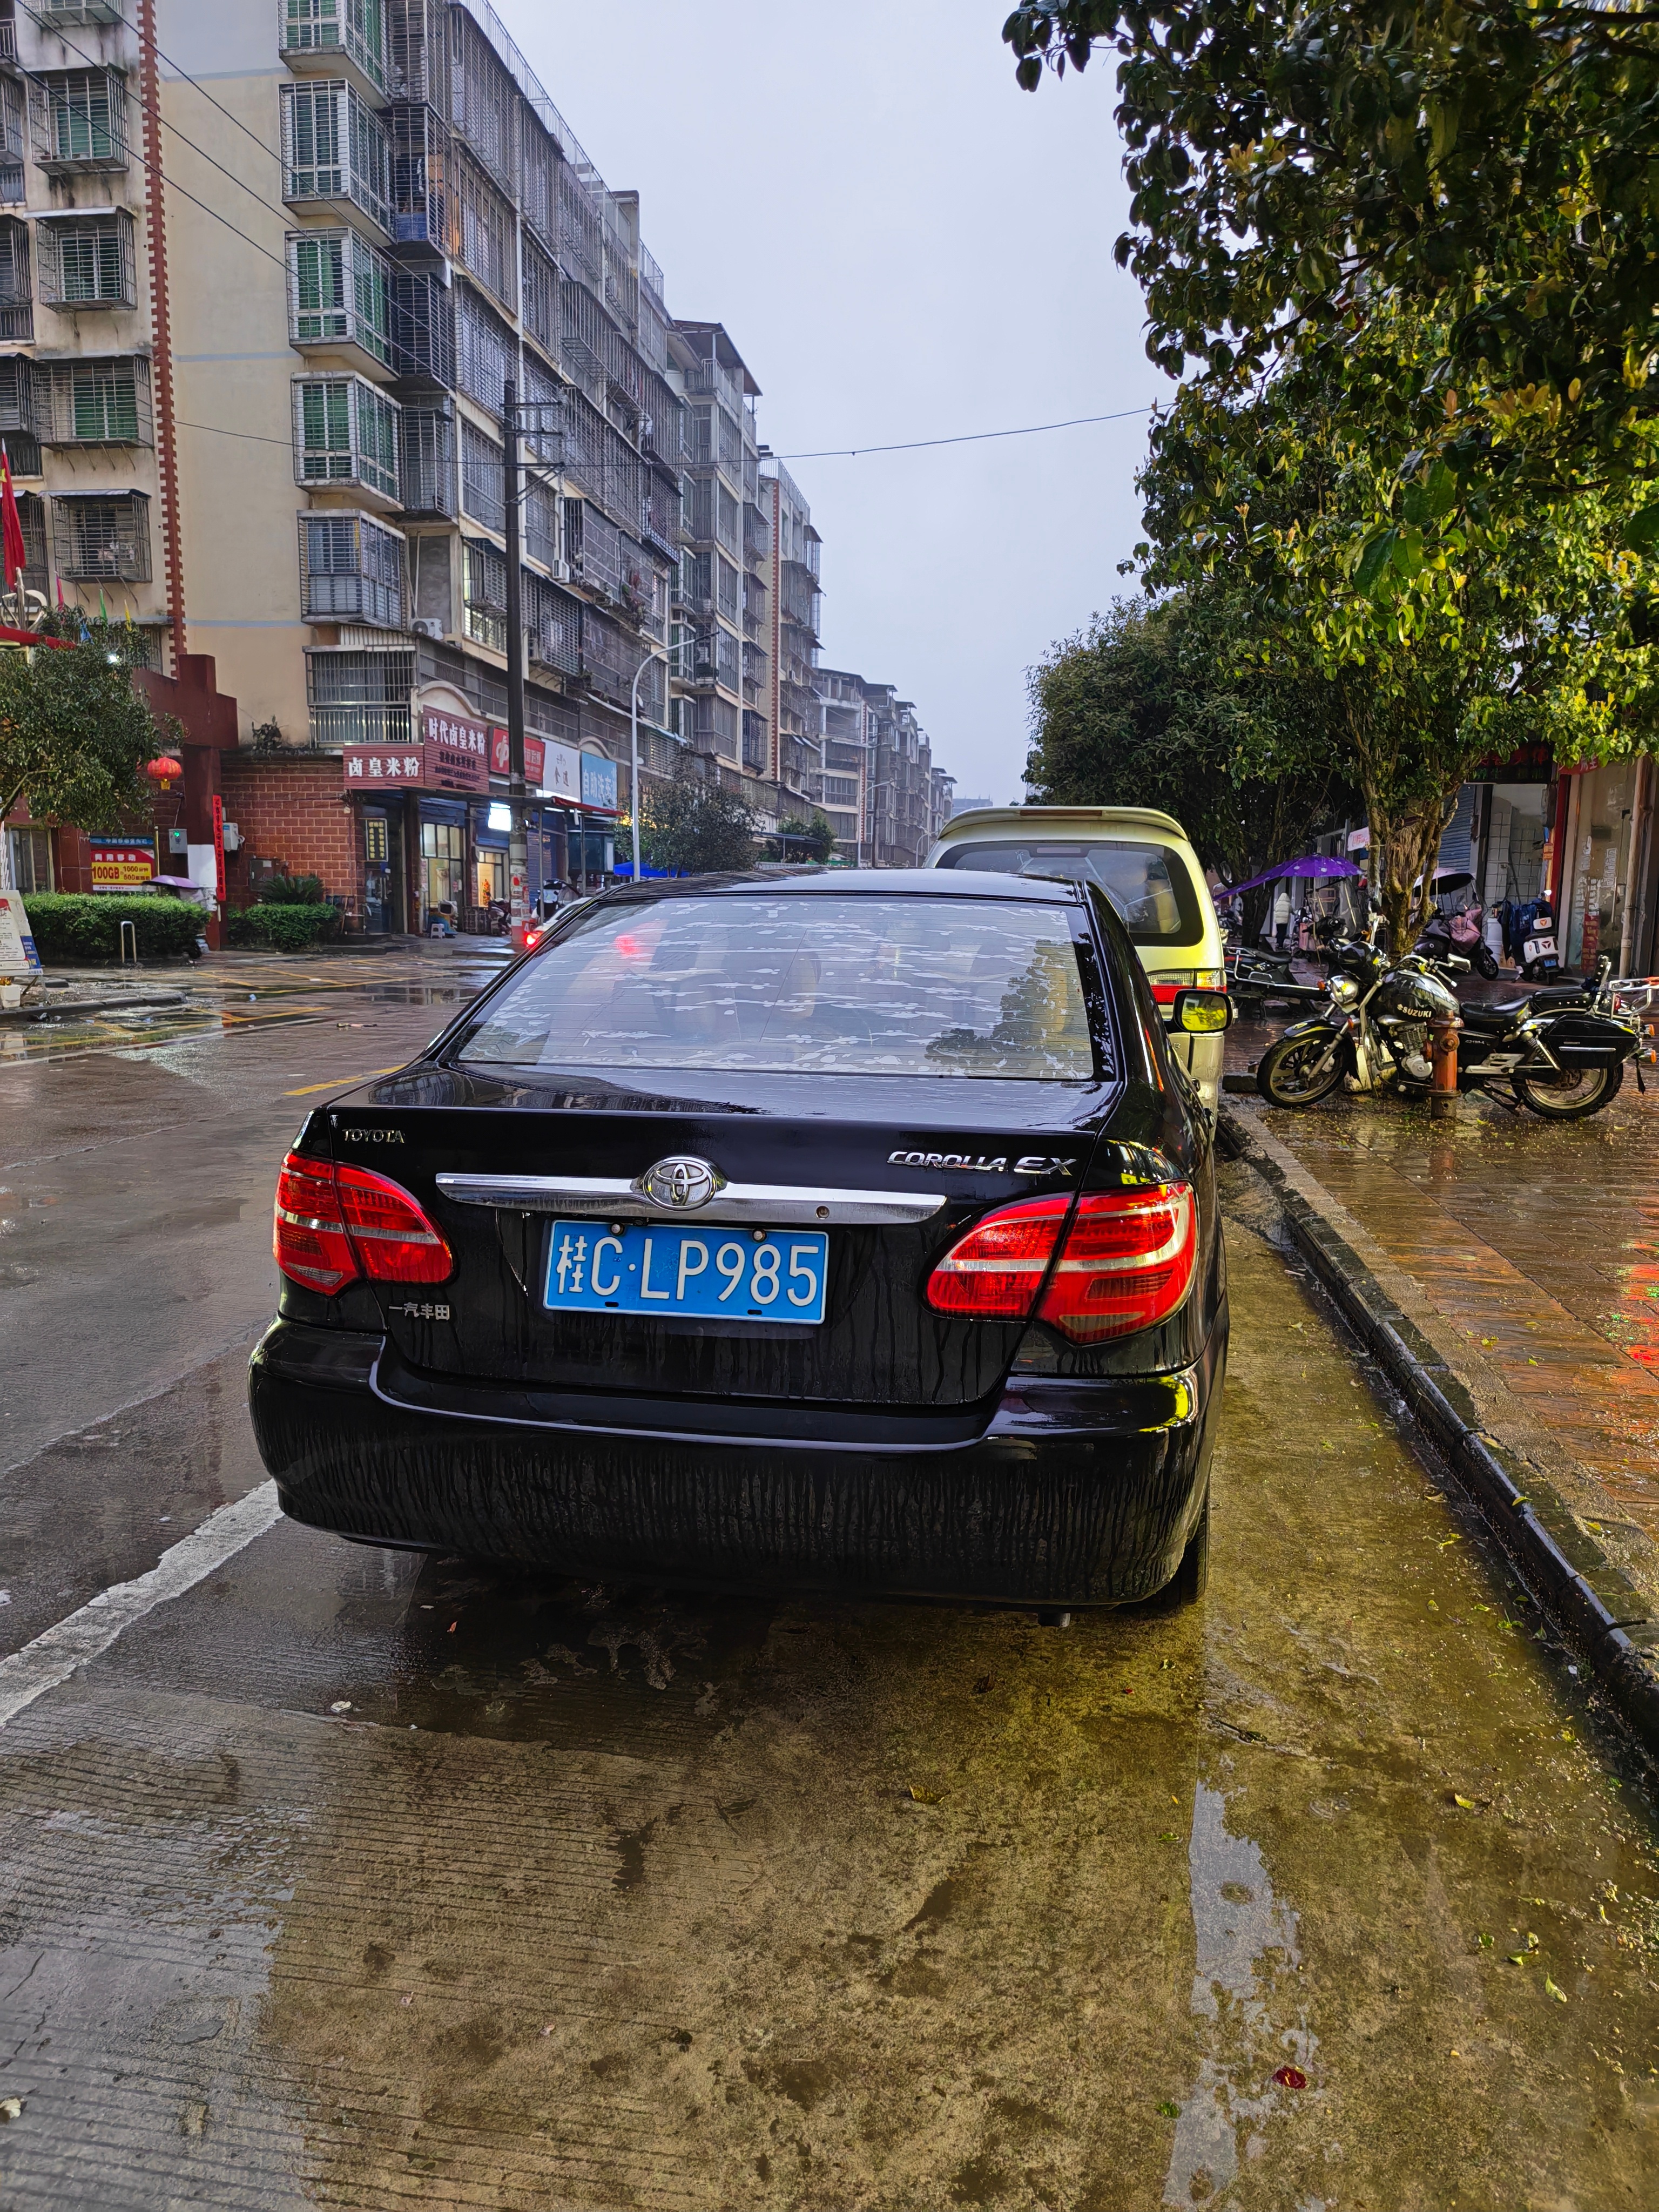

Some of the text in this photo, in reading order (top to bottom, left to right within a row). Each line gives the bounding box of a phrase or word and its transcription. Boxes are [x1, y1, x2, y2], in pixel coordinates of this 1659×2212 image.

[428, 717, 485, 756] 时代卤皇米粉
[348, 757, 420, 778] 卤皇米粉
[1402, 1007, 1432, 1018] SUZUKI
[342, 1129, 405, 1143] TOYOTA
[887, 1151, 1077, 1176] COROLLA EX
[556, 1235, 819, 1306] 桂C·LP985
[388, 1301, 450, 1321] 一汽丰田
